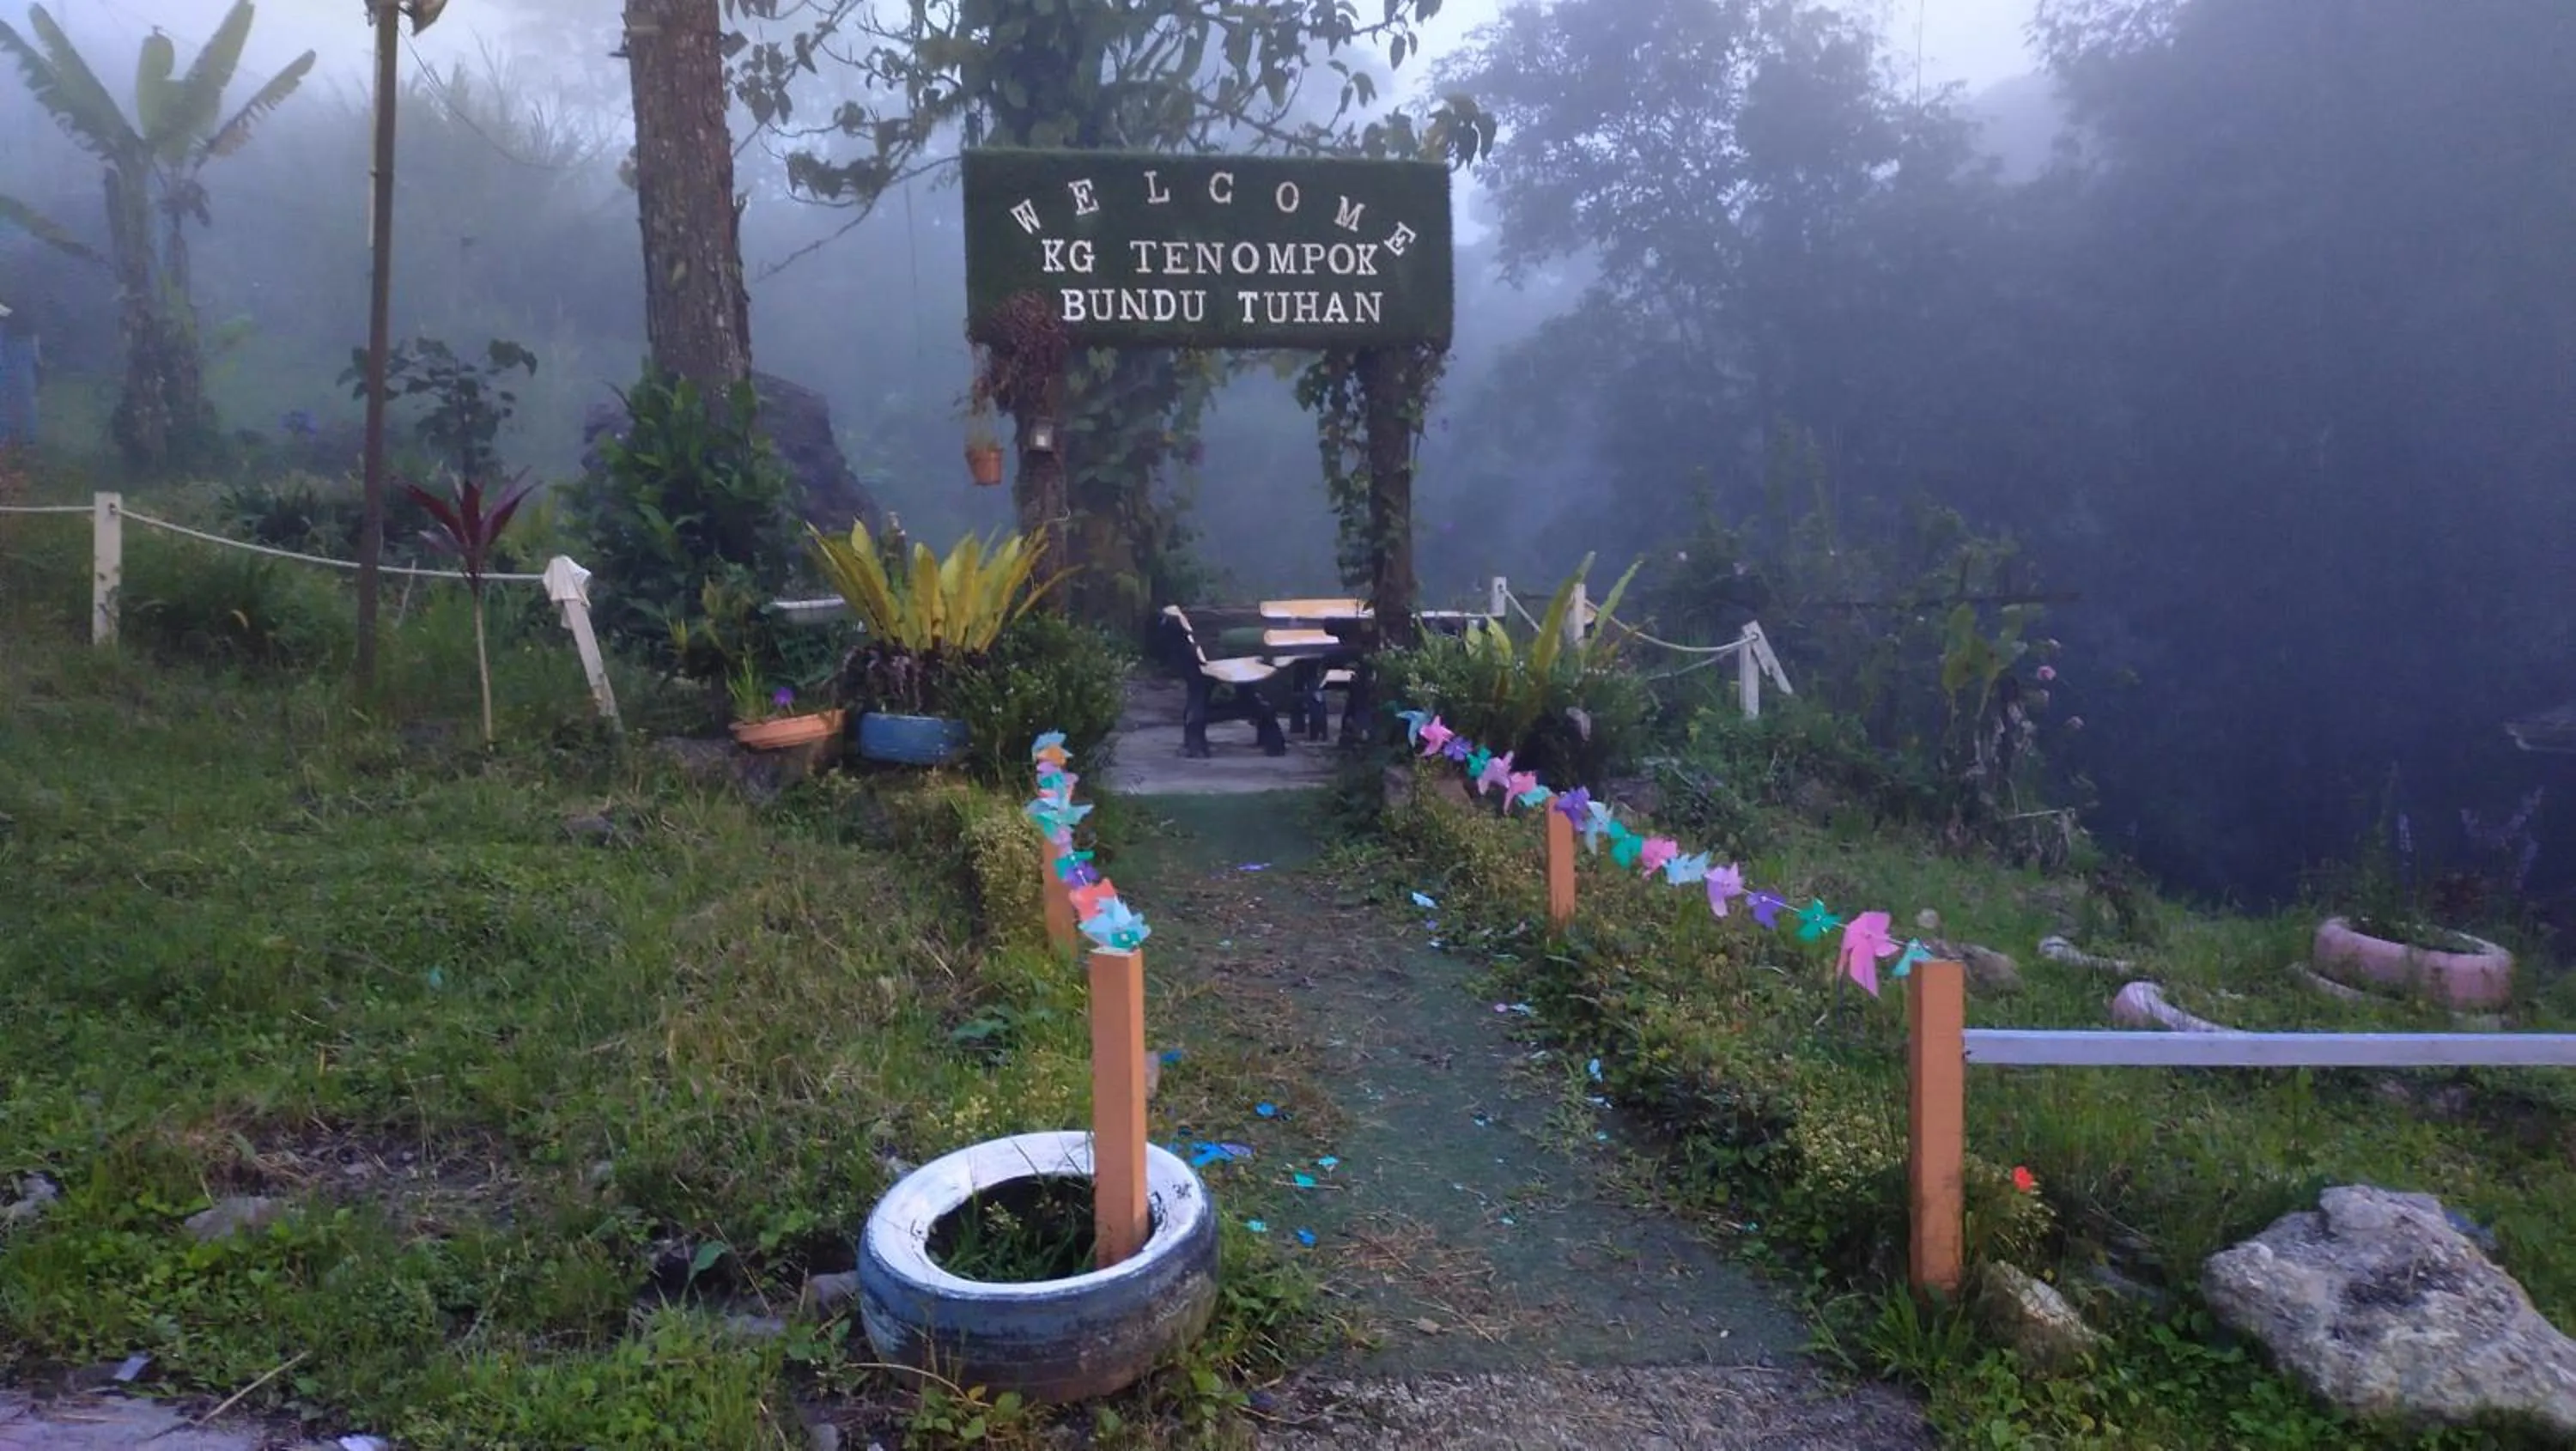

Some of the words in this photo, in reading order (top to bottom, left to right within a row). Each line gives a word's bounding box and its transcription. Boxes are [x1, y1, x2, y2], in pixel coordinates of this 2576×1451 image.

[1010, 170, 1417, 257] WELCOME
[1041, 238, 1097, 273] KG
[1129, 240, 1379, 276] TENOMPOK
[1060, 288, 1207, 322] BUNDU
[1236, 290, 1383, 324] TUHAN
